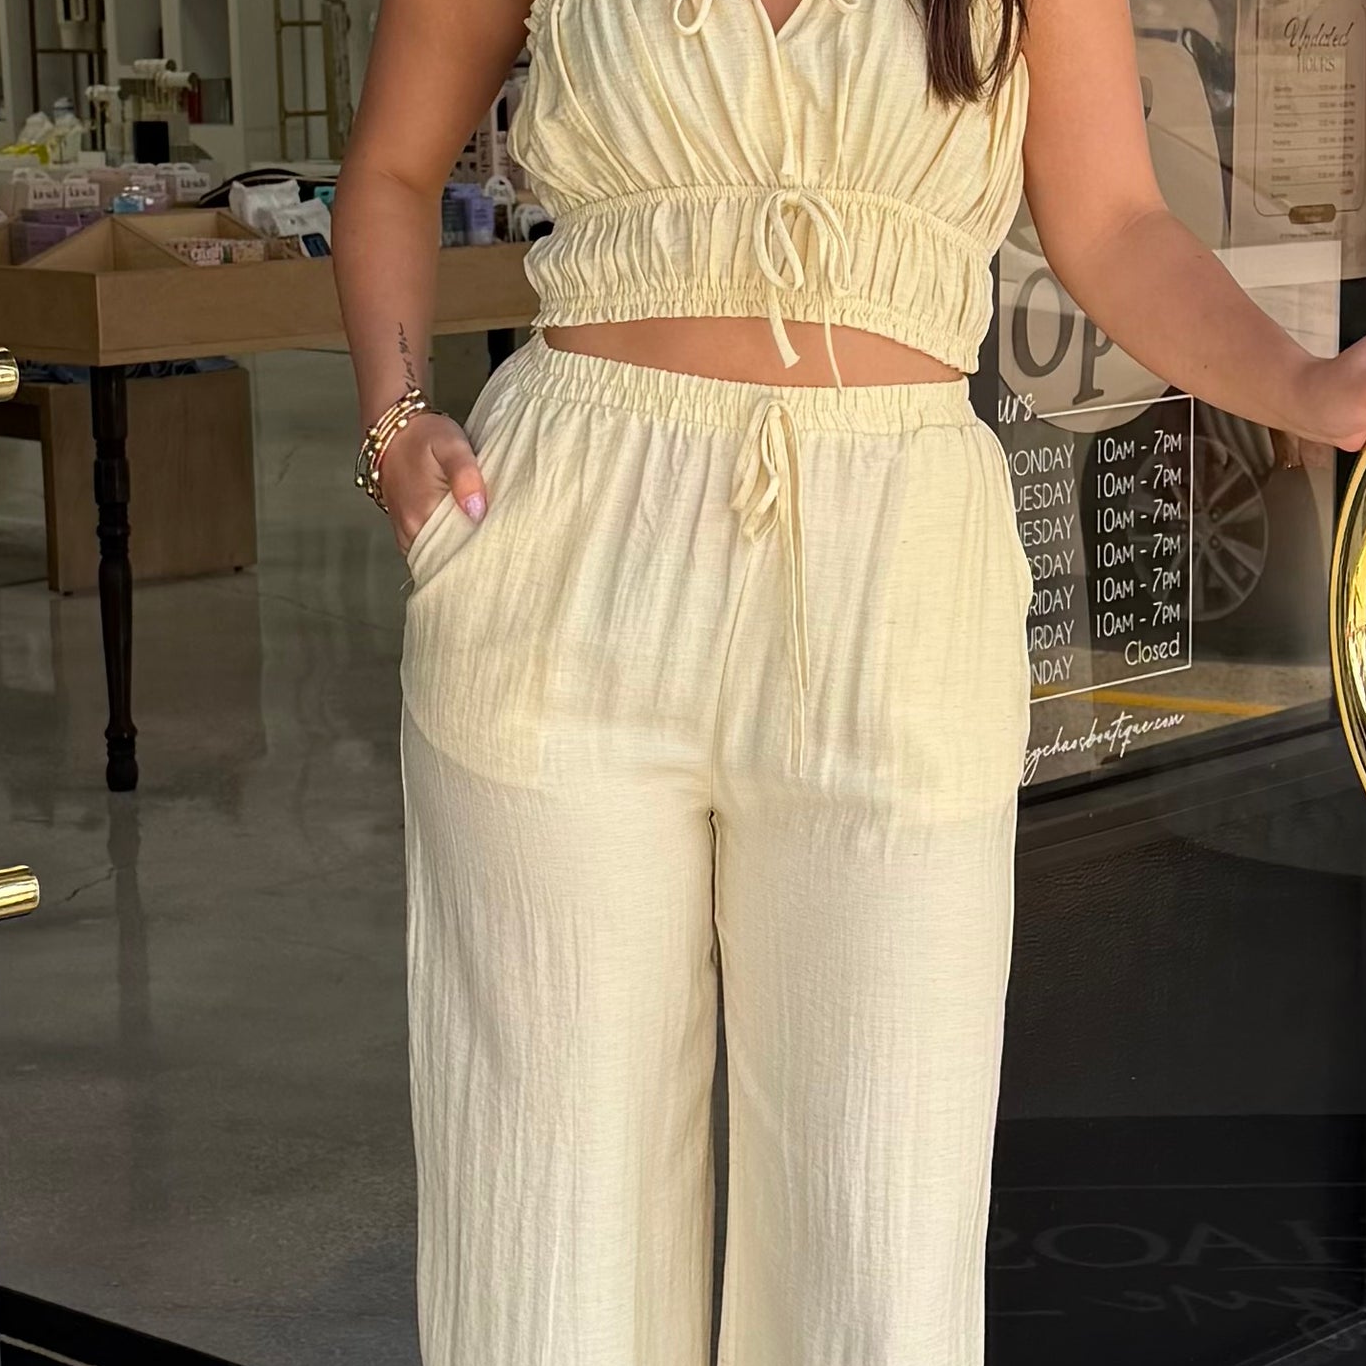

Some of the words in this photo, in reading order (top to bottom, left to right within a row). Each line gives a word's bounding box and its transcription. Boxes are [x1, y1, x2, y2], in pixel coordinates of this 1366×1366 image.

[1097, 437, 1134, 465] 10AM
[1152, 430, 1182, 456] 7PM
[1097, 472, 1134, 500] 10AM
[1152, 464, 1182, 490] 7PM
[1097, 507, 1134, 534] 10AM
[1152, 498, 1182, 525] 7PM
[1097, 542, 1134, 569] 10AM
[1152, 533, 1182, 559] 7PM
[1097, 576, 1134, 604] 10AM
[1152, 567, 1182, 594] 7PM
[1097, 611, 1134, 639] 10AM
[1152, 601, 1182, 627] 7PM
[1124, 632, 1181, 666] Closed
